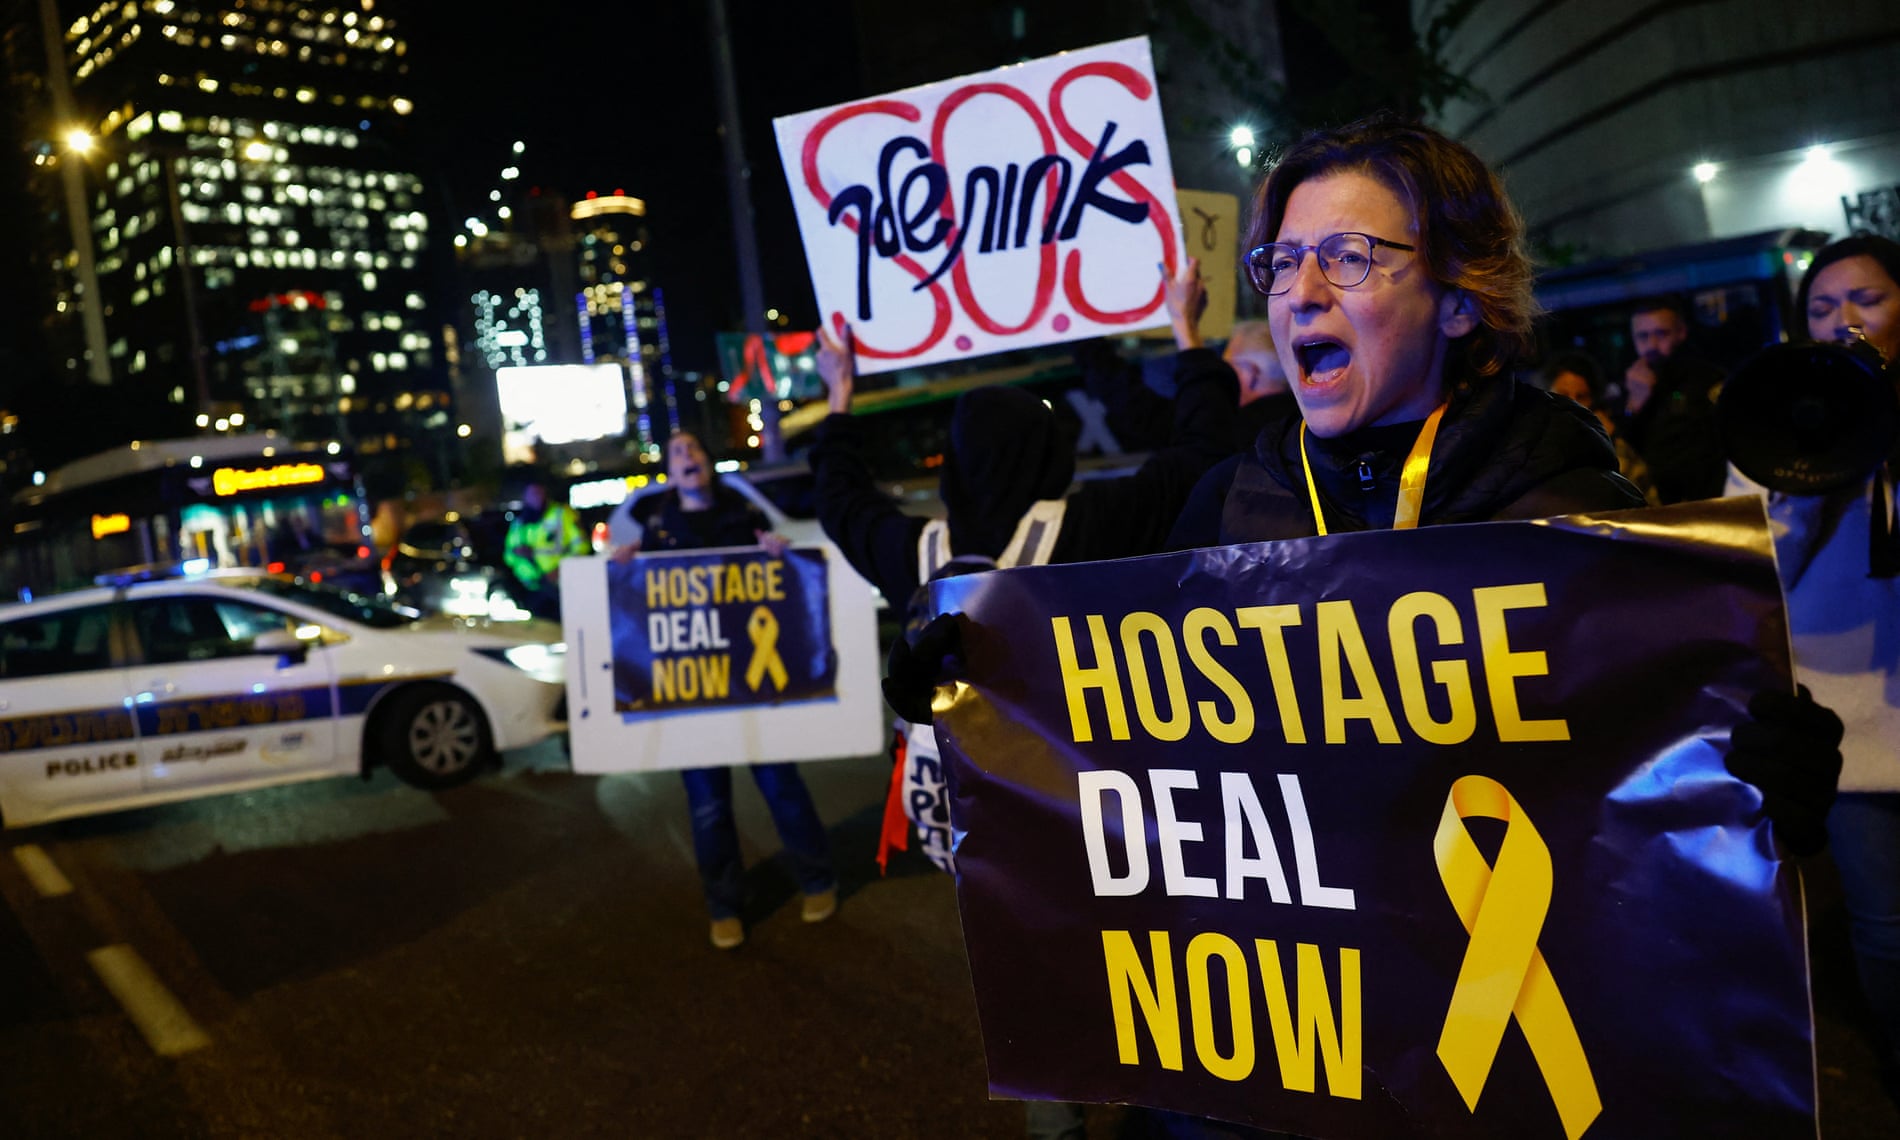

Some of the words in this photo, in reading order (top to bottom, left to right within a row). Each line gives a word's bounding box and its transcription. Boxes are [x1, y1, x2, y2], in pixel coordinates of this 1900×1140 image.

[646, 560, 786, 609] HOSTAGE
[648, 608, 731, 653] DEAL
[651, 653, 731, 703] NOW
[1052, 582, 1571, 745] HOSTAGE
[45, 751, 138, 779] POLICE
[1078, 768, 1356, 911] DEAL
[1102, 930, 1363, 1102] NOW
